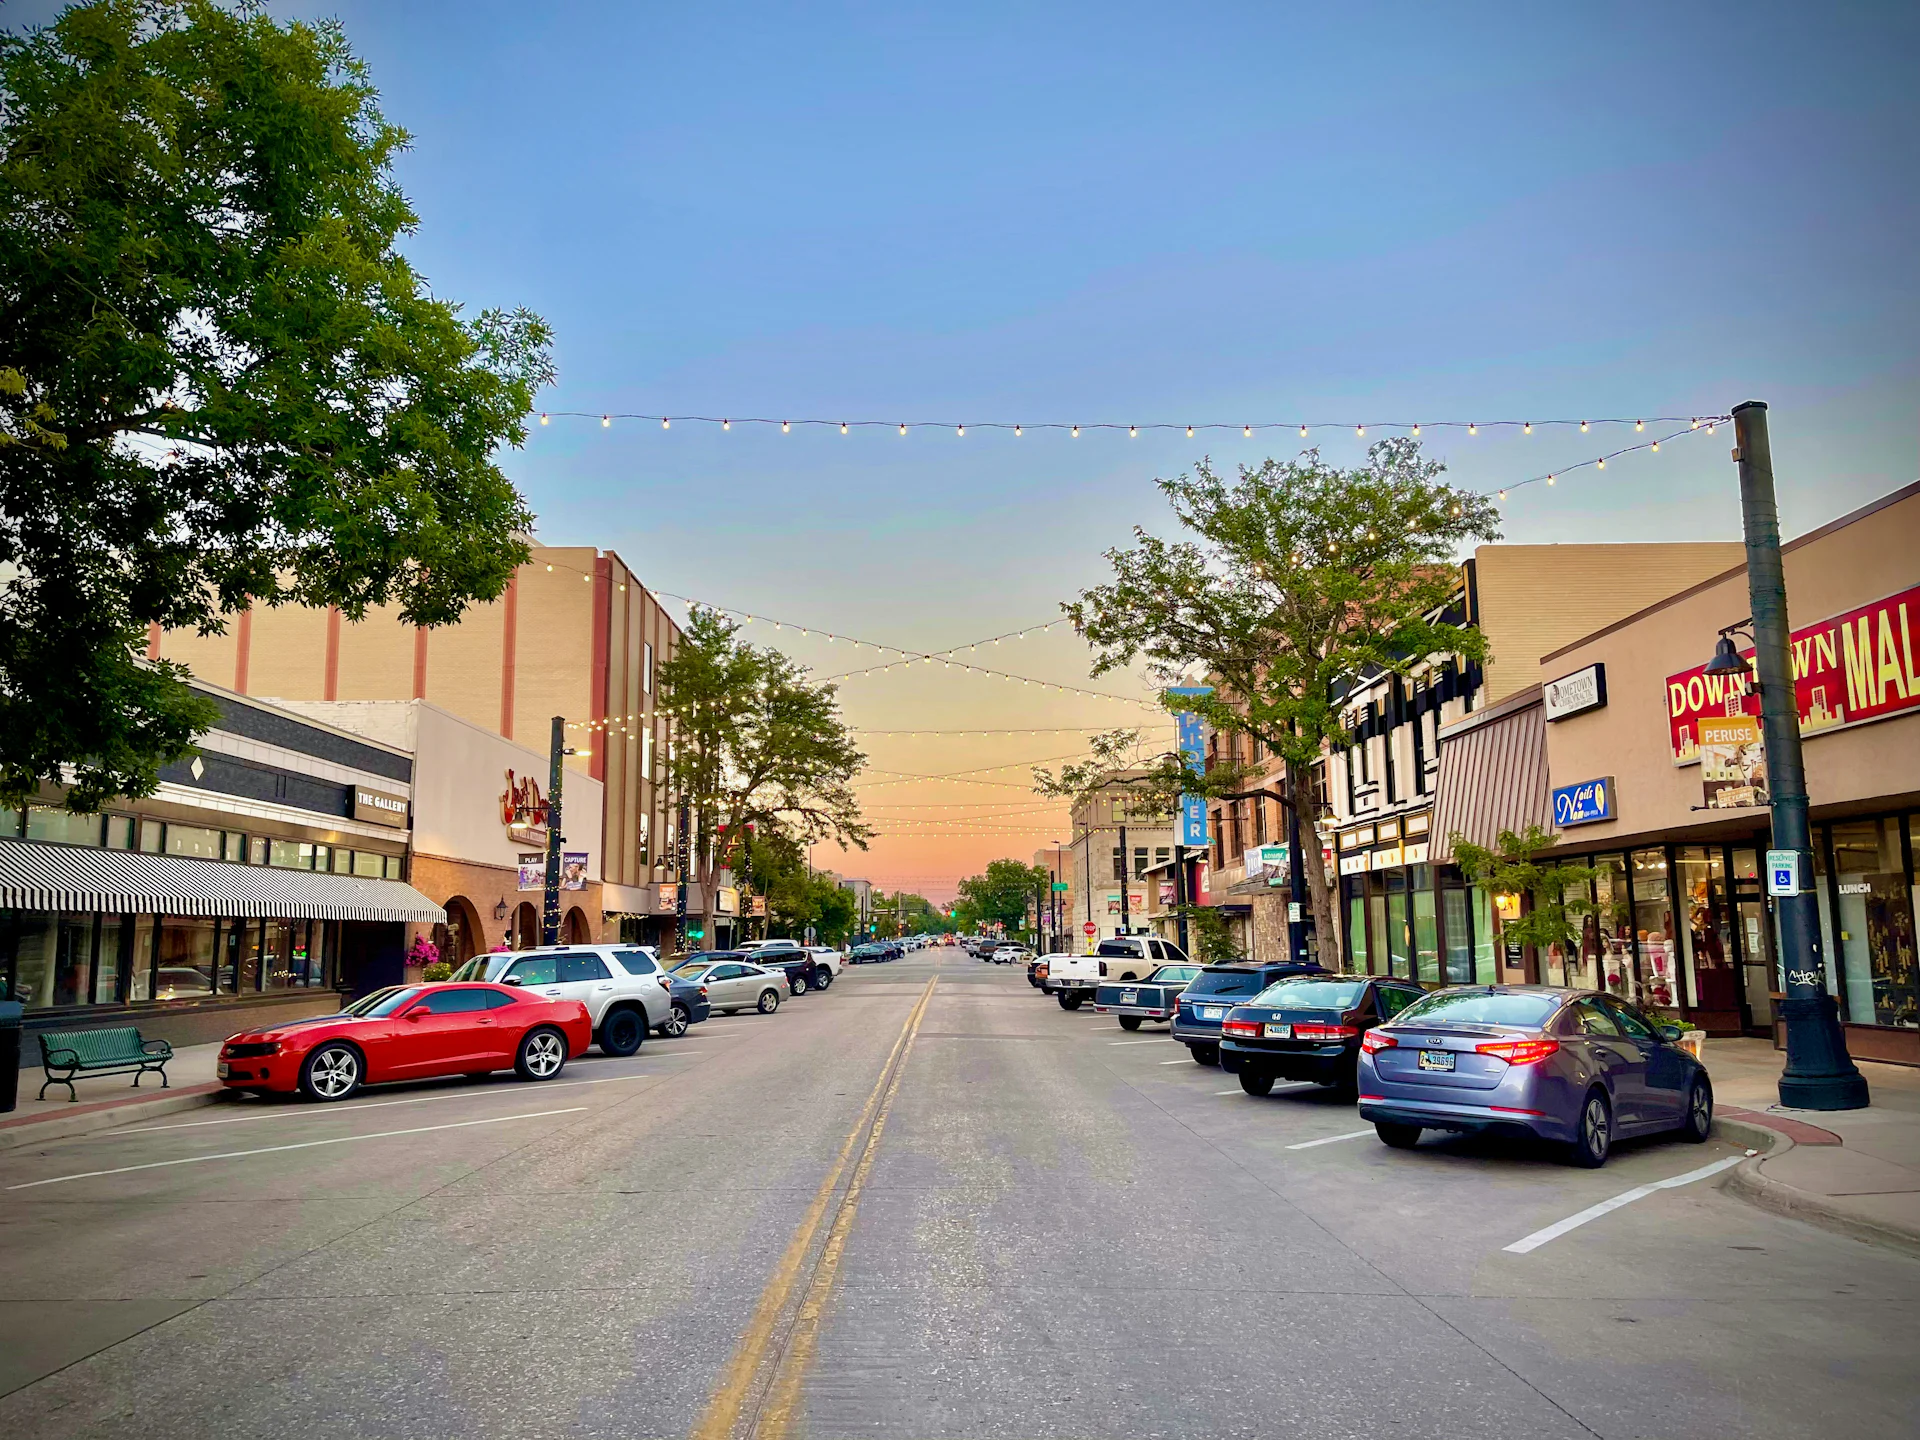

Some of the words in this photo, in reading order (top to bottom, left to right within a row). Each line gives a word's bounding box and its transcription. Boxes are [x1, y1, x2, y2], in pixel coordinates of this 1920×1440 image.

[1668, 629, 1838, 718] DOWNTWN
[1705, 728, 1753, 742] PERUSE
[358, 792, 373, 806] THE
[374, 796, 406, 813] GALLERY
[1557, 785, 1593, 823] Nails
[1838, 883, 1872, 894] LUNCH
